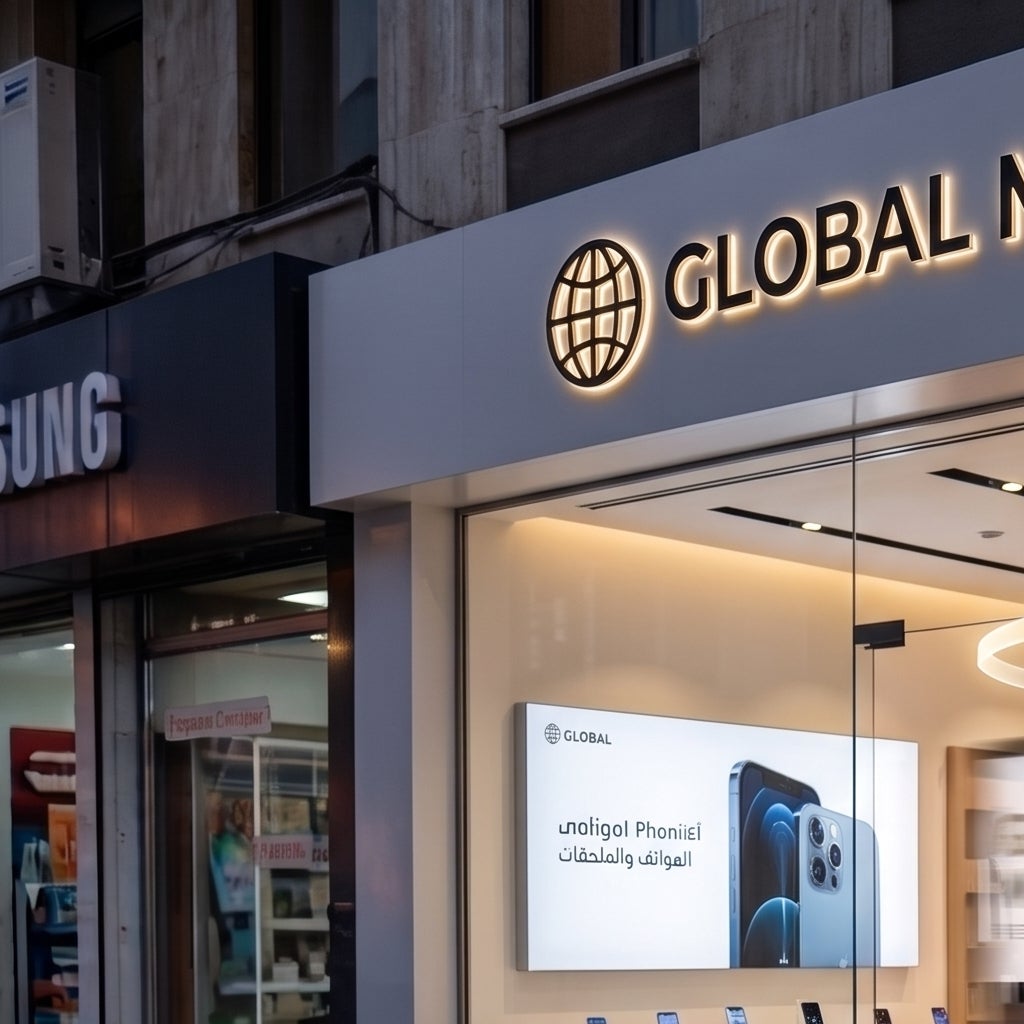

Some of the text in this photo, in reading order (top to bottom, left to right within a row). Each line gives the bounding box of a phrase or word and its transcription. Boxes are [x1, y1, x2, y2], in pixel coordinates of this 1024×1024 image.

[664, 173, 973, 324] GLOBAL
[0, 371, 122, 494] UNG
[563, 729, 612, 746] GLOBAL
